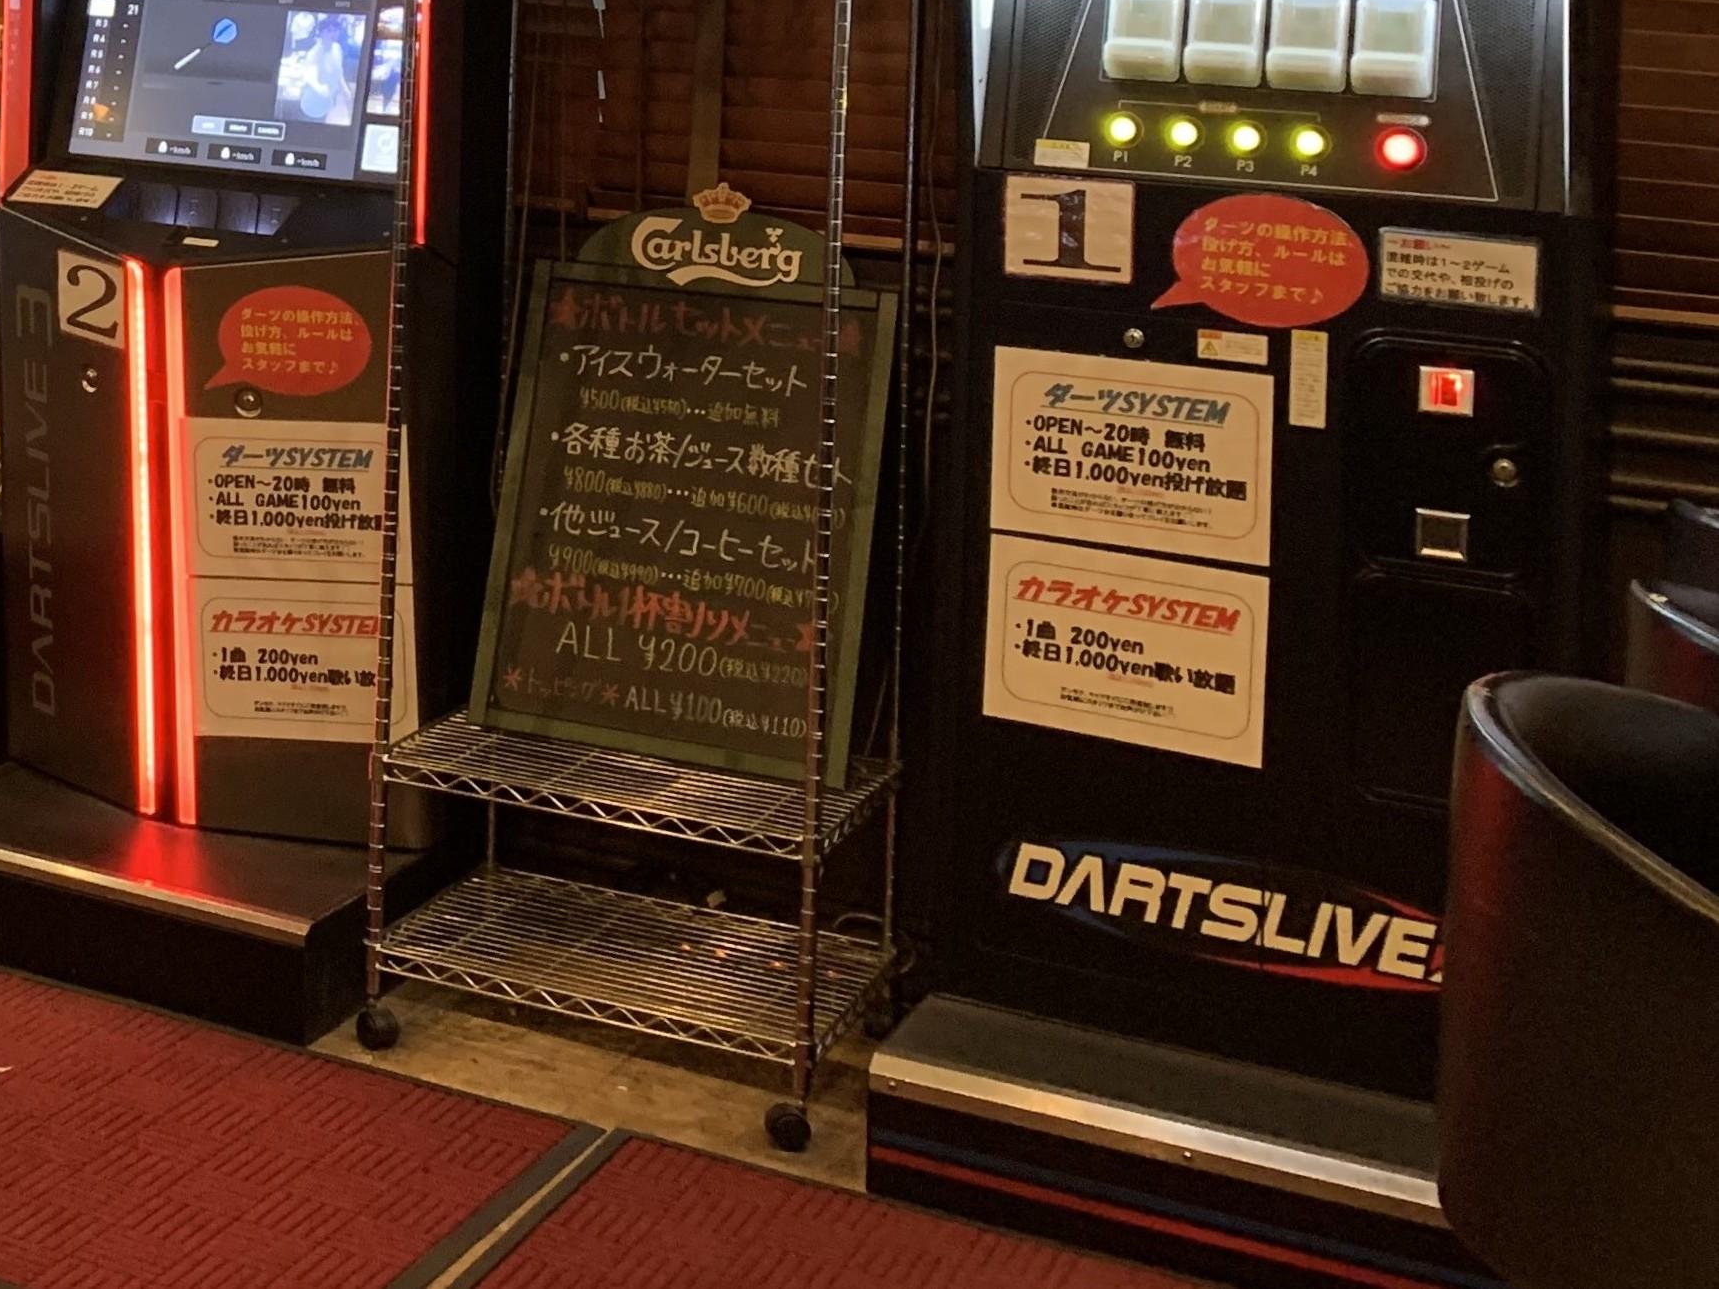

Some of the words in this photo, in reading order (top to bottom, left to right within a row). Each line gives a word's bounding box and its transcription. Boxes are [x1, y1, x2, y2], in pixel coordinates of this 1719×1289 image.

[1113, 150, 1129, 163] P1
[1174, 155, 1193, 169] P2
[1235, 159, 1255, 174] P3
[1299, 164, 1319, 178] P4
[1020, 189, 1122, 273] 1
[630, 216, 802, 288] Carlsberg
[66, 263, 120, 340] 2
[1044, 382, 1232, 425] ダーツSYSTEM
[221, 443, 374, 469] ダーツSYSTEM
[1033, 436, 1069, 456] ALL
[216, 493, 245, 507] ALL
[1017, 575, 1242, 634] カラオケSYSTEM
[211, 609, 379, 634] カラオケSYSTE
[1068, 625, 1146, 656] 200yen
[258, 648, 319, 666] 200yen
[1008, 841, 1444, 984] DARTSLIVE
